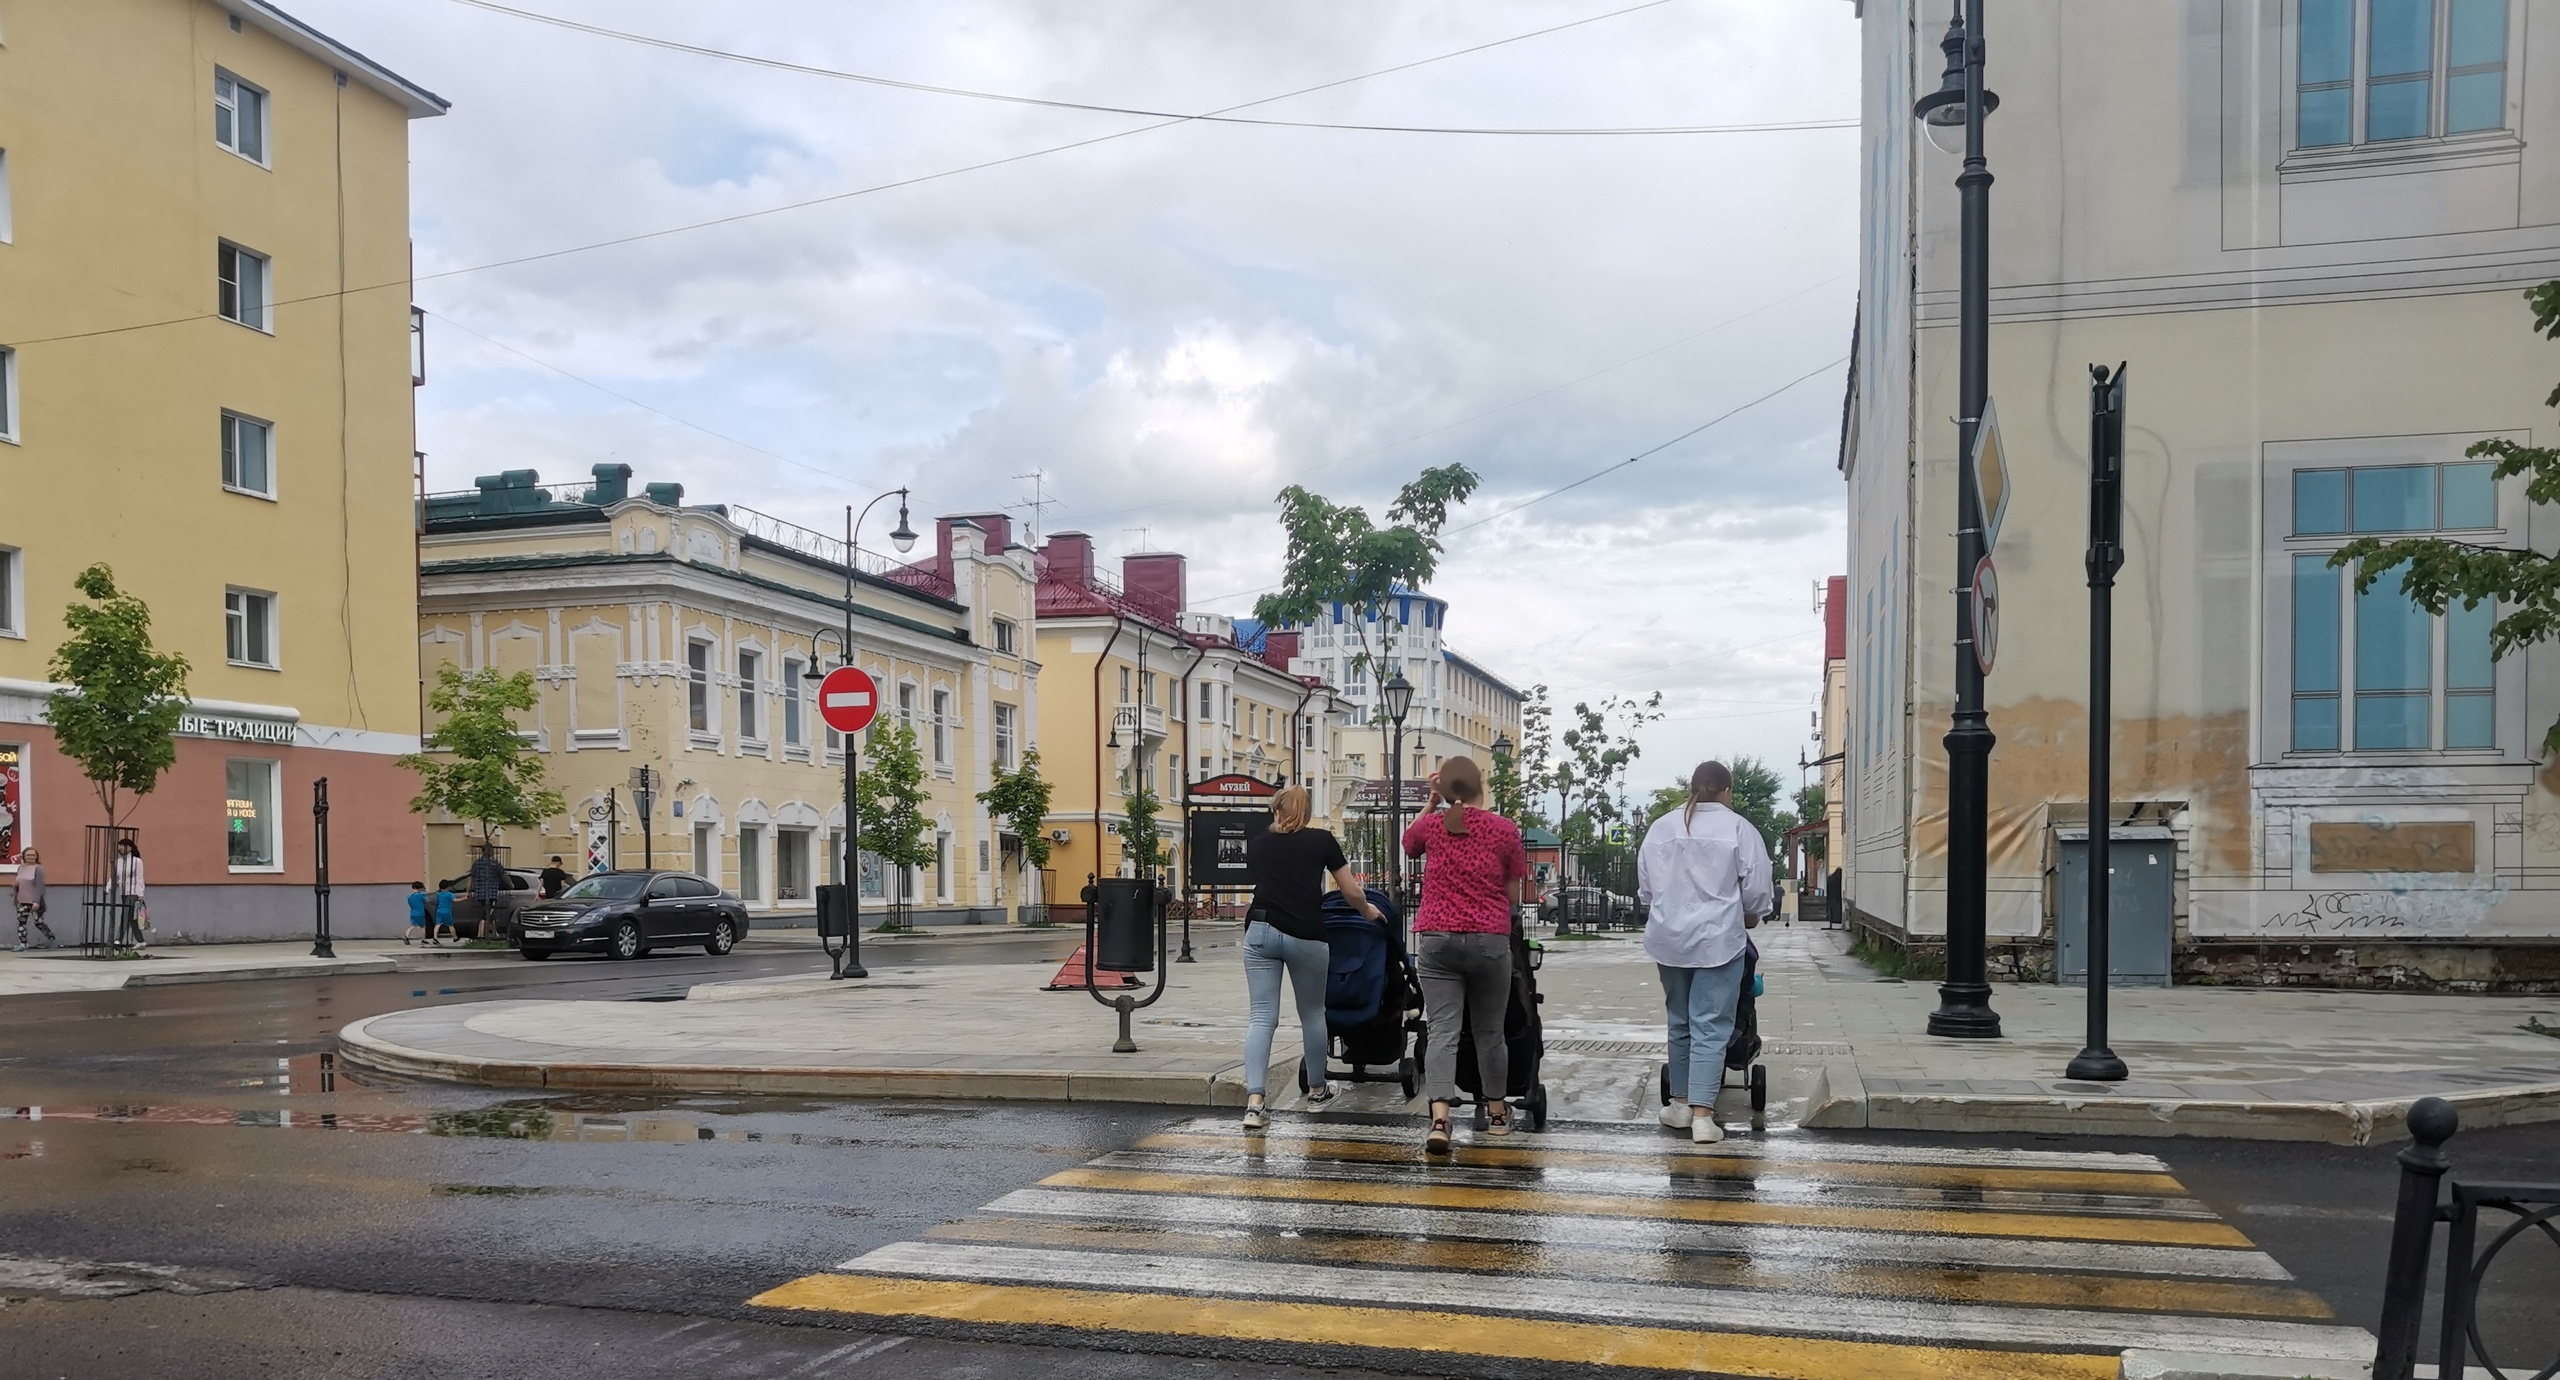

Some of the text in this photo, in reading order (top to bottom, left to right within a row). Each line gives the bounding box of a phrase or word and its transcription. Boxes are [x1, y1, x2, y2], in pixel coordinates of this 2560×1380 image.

[215, 719, 298, 742] ТРАДИЦИИ
[1219, 781, 1251, 792] МУЗЕЙ
[239, 809, 257, 818] КОФЕ
